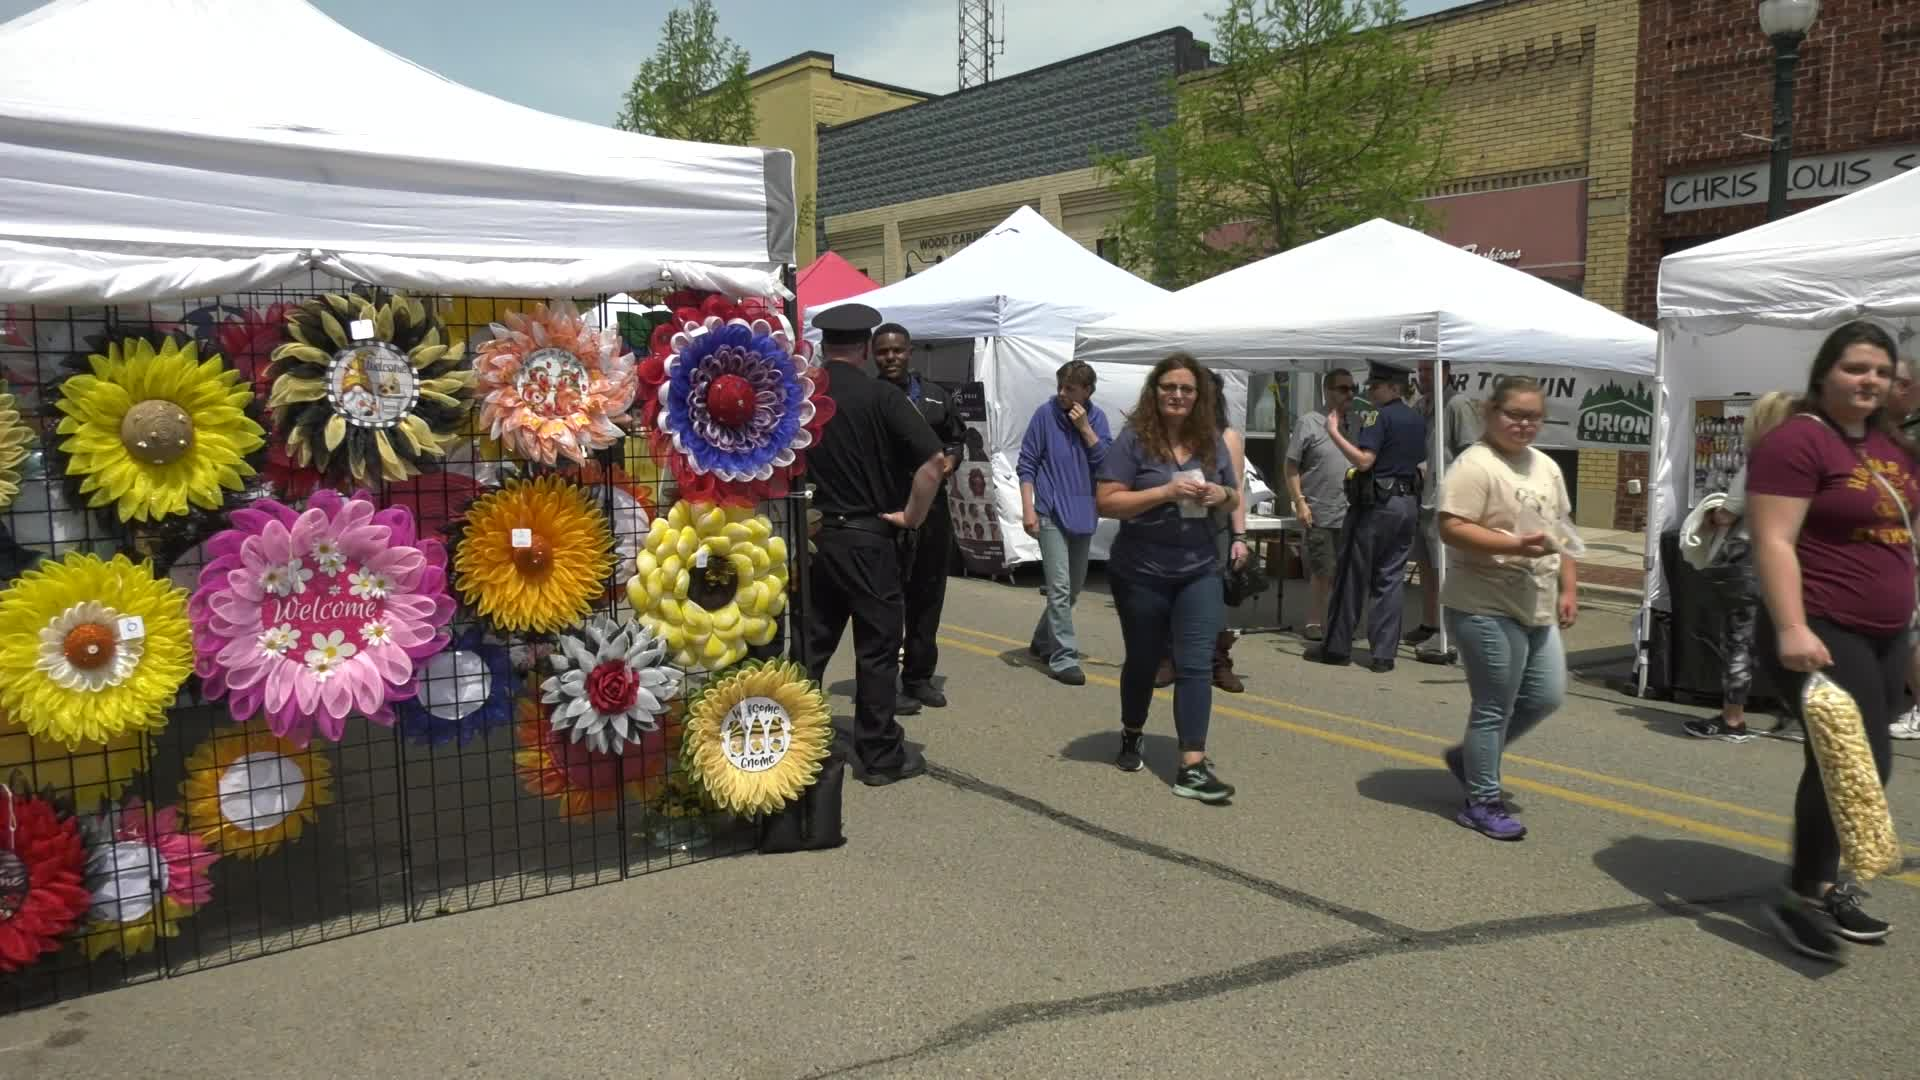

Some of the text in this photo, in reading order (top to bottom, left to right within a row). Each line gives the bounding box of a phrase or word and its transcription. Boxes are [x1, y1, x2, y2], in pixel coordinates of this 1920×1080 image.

[1670, 172, 1758, 205] CHRIS
[1787, 158, 1871, 191] OUIS
[919, 235, 949, 250] WOOD
[1536, 376, 1577, 398] IN
[1583, 411, 1651, 436] ORION
[272, 596, 378, 624] Welcome
[732, 703, 781, 719] Wlcome
